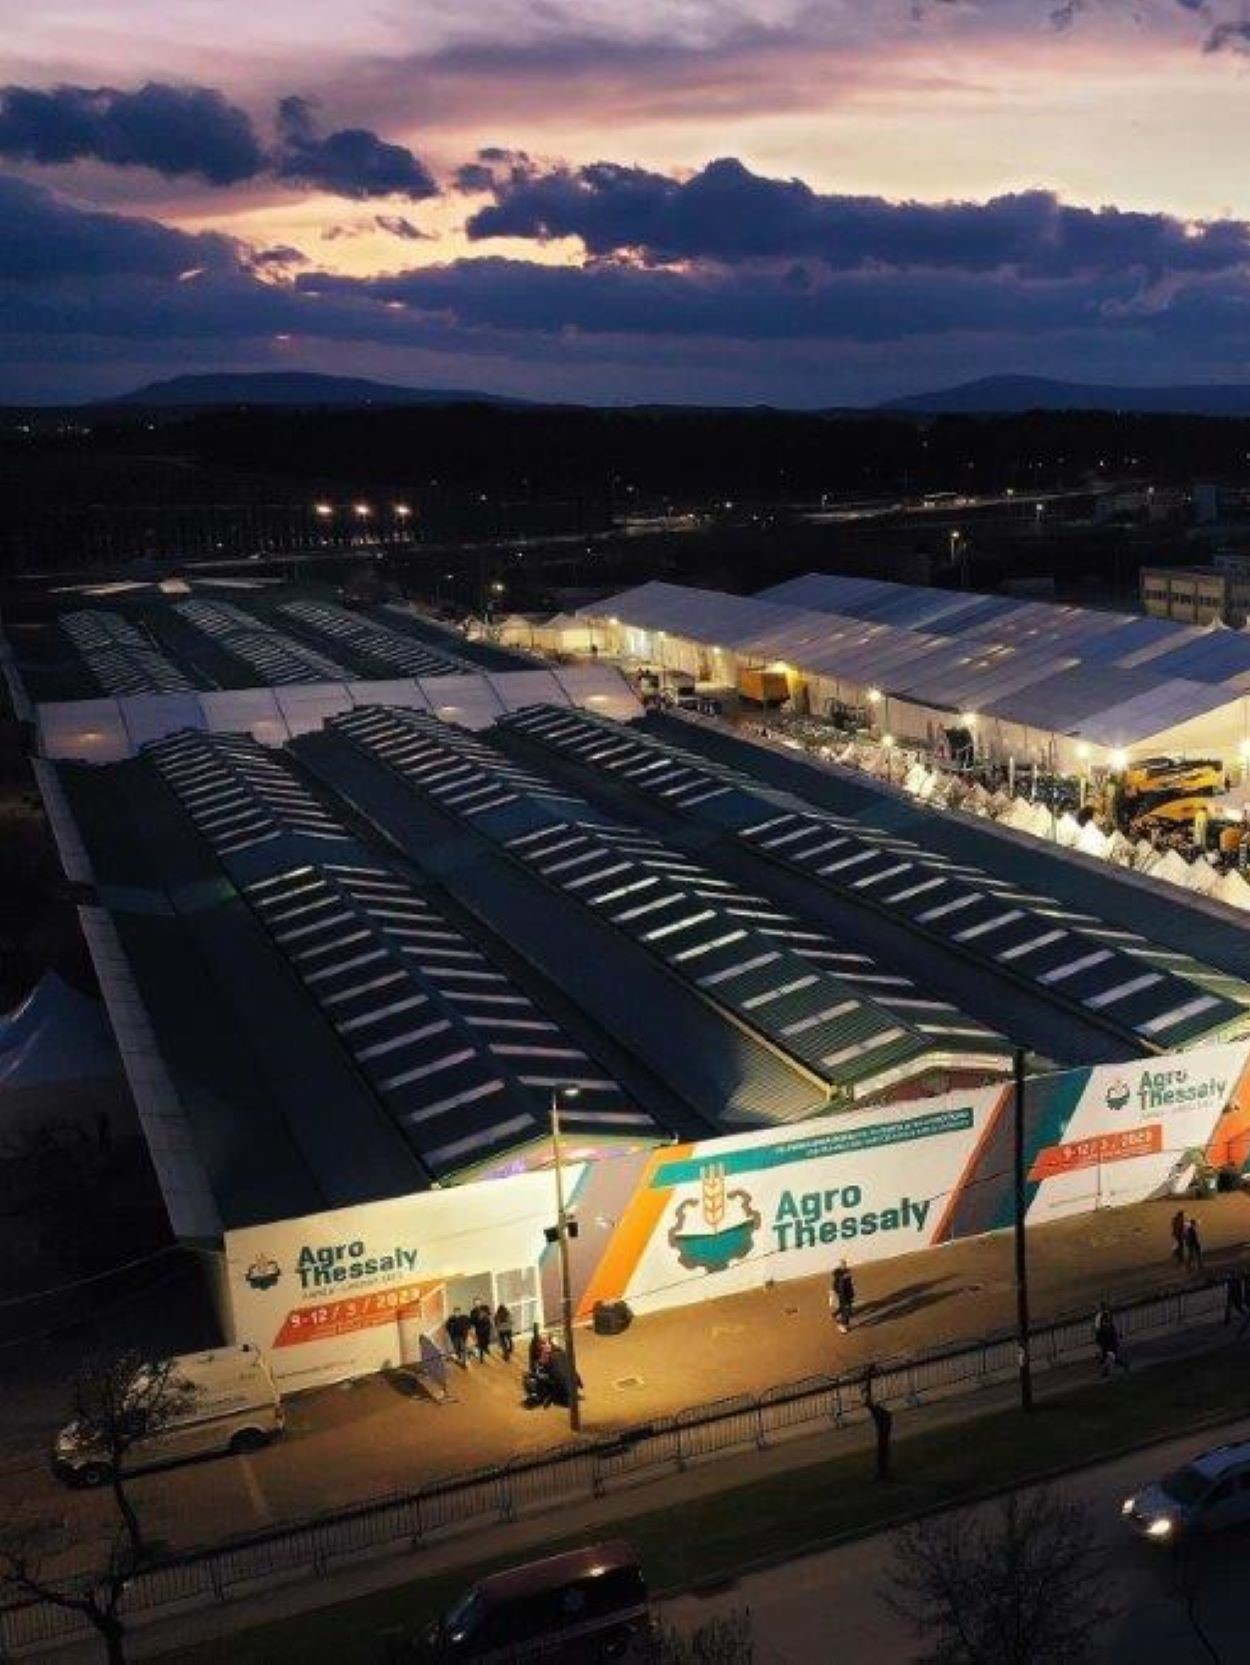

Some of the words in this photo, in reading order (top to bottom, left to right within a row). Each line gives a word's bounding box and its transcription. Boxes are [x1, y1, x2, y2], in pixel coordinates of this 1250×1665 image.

[1137, 1078, 1226, 1110] Thessaly
[1141, 1070, 1187, 1091] Agro
[776, 1185, 862, 1225] Agro
[773, 1197, 931, 1252] Thessaly
[297, 1247, 417, 1289] Thessaly
[300, 1241, 364, 1268] Agro
[290, 1308, 328, 1328] 9-12
